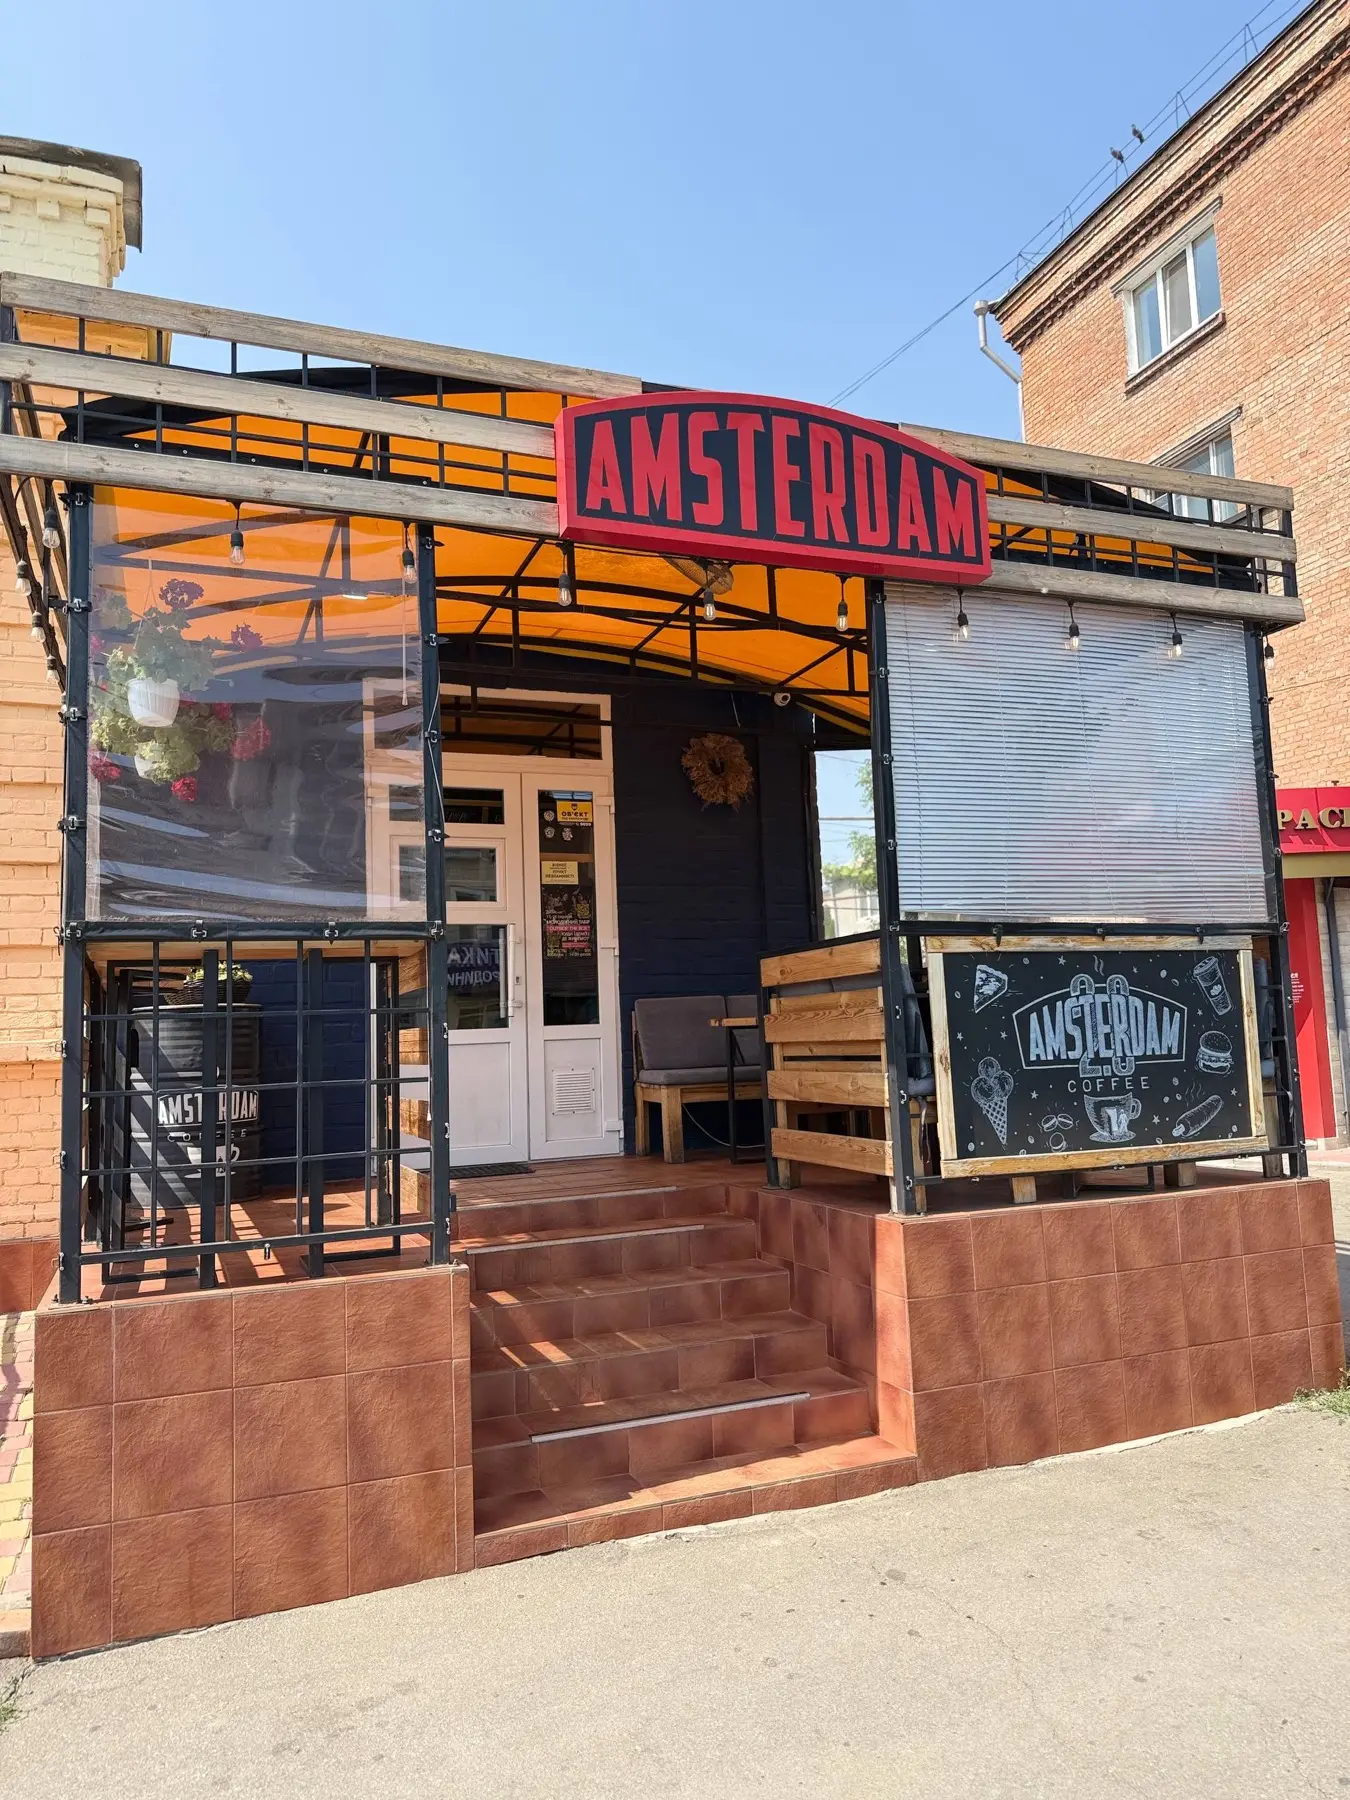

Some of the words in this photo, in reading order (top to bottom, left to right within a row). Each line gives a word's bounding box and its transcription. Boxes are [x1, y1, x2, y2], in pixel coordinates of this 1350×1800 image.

[585, 411, 977, 557] AMSTERDAM
[1029, 993, 1181, 1061] AMSTERDAM
[158, 1090, 257, 1124] AMSTRDAM
[1067, 1076, 1150, 1093] COFFEE
